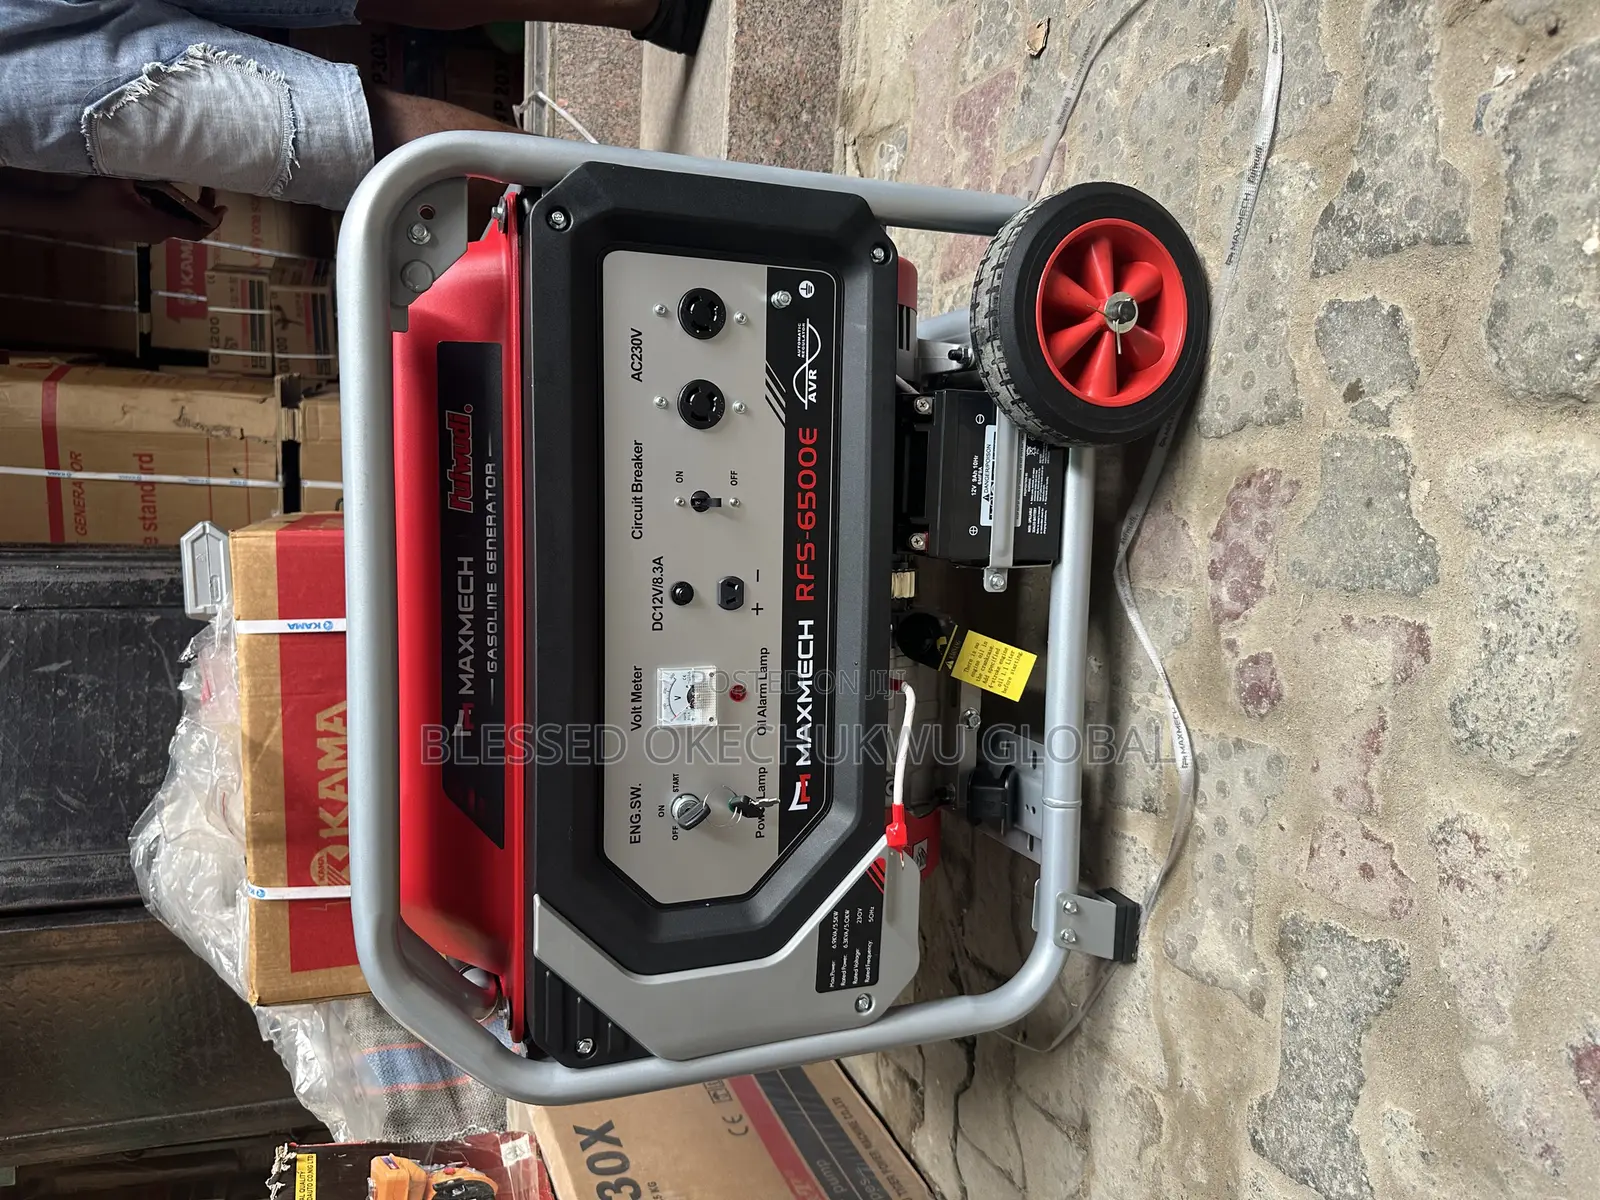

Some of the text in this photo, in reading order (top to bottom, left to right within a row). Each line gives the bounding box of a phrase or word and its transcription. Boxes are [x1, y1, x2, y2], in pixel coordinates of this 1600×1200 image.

[1229, 192, 1251, 252] MAXMECH
[630, 328, 643, 382] AC230V
[808, 368, 818, 404] AVR
[69, 451, 87, 536] GENERAOR
[133, 452, 158, 531] standrd
[630, 440, 643, 540] Circuit Breaker
[675, 470, 684, 484] ON
[730, 470, 738, 486] OFF
[984, 444, 992, 494] DANGER/POISON
[484, 462, 498, 673] GASOLINE GENERATOR
[652, 556, 664, 632] DC12V/8.3A
[795, 427, 818, 766] MAXMECH RFS-6500E
[288, 621, 322, 632] KAMA
[457, 556, 475, 696] MAXMECH
[963, 658, 973, 672] There
[970, 660, 980, 678] engine
[987, 648, 1000, 673] specified
[999, 647, 1008, 665] engine
[1004, 650, 1015, 665] Liter
[630, 665, 643, 731] Volt Meter
[756, 647, 771, 736] Oil Alarm Lamp
[1001, 677, 1012, 693] before
[1170, 706, 1188, 754] MAXMECH
[316, 700, 348, 838] KAMA
[672, 773, 680, 793] START
[630, 783, 642, 844] ENG.SW.
[658, 804, 665, 818] ON
[755, 766, 768, 838] Pow Lamp
[573, 1119, 642, 1200] 30X
[815, 1158, 847, 1194] pump
